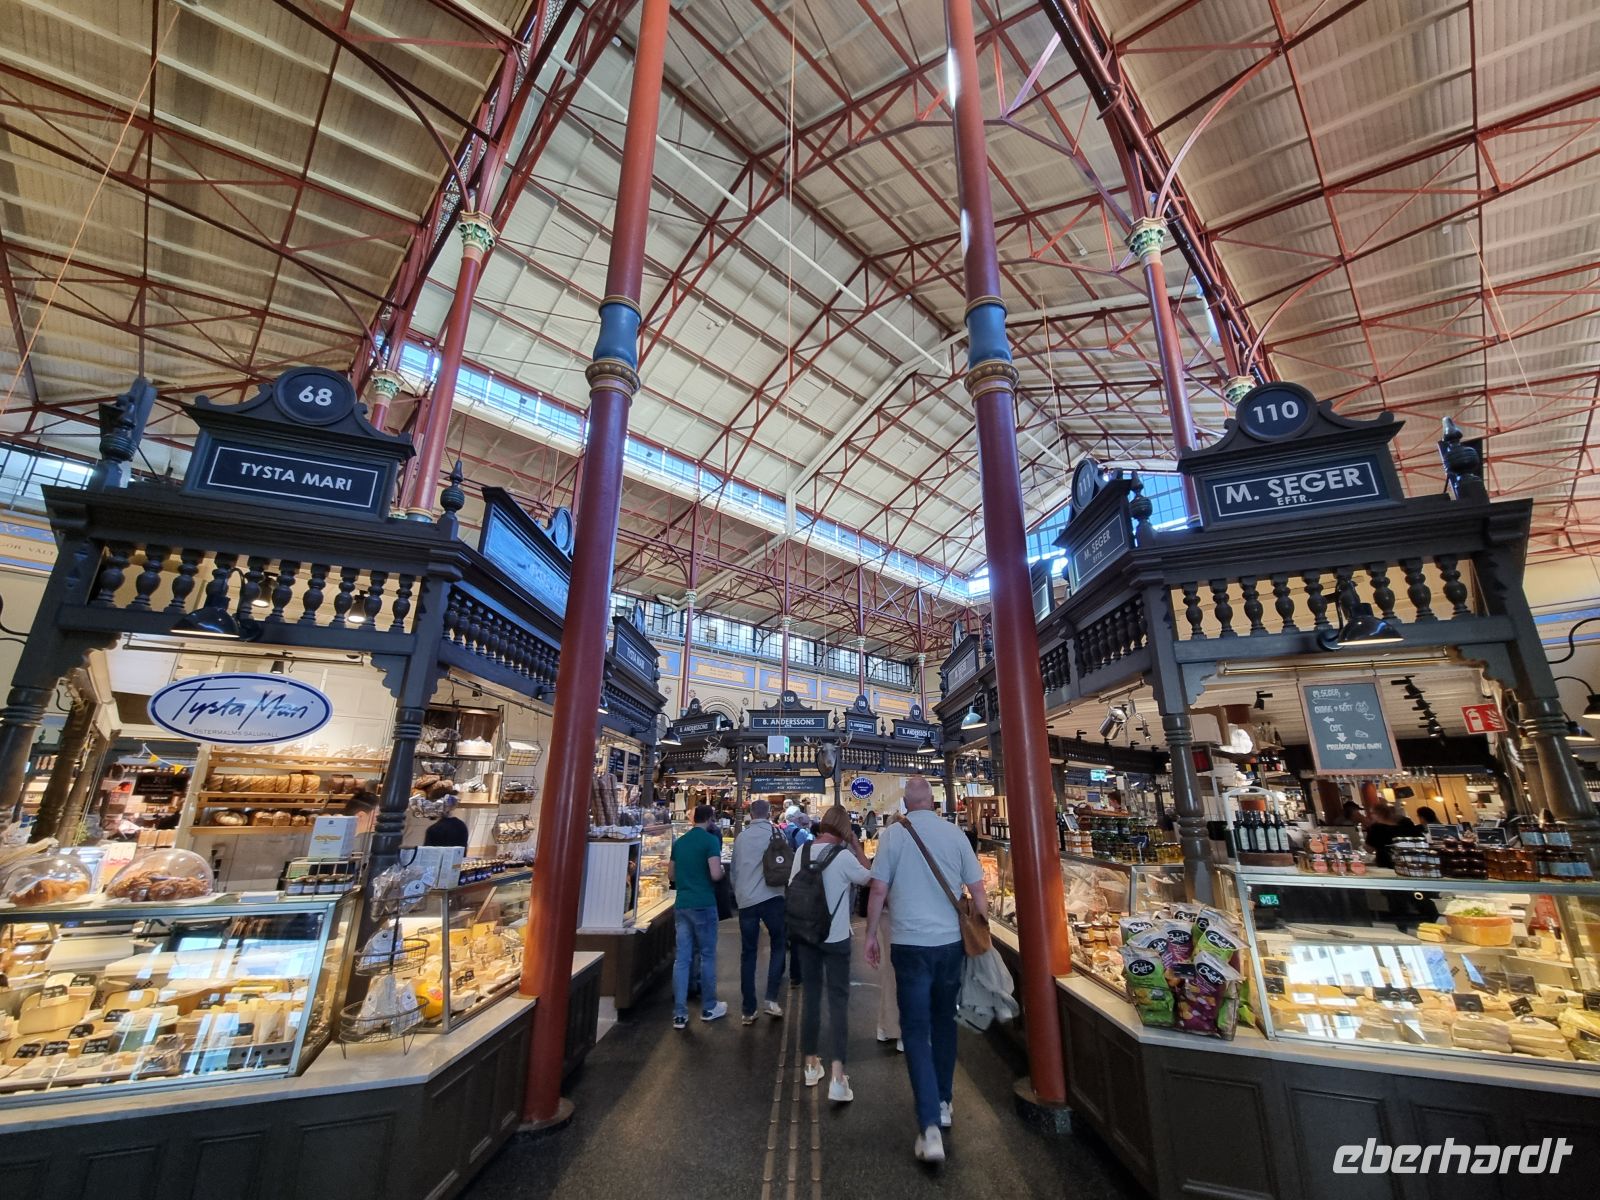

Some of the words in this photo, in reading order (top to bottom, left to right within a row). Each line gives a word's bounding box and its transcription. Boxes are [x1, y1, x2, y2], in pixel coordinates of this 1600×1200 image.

[299, 385, 333, 407] 68
[1252, 400, 1299, 424] 110
[241, 462, 296, 483] TYSTA
[301, 472, 353, 491] MARI
[1079, 473, 1091, 496] 111
[1226, 483, 1260, 504] M.
[1269, 468, 1363, 498] SEGER
[1277, 494, 1313, 506] EFTR.
[1084, 548, 1092, 561] M.
[1091, 529, 1111, 553] SEGER
[172, 683, 245, 725] Tysta
[238, 689, 314, 731] Mari
[762, 718, 769, 726] B.
[770, 718, 815, 726] ANDERSSONS
[243, 730, 279, 738] SALUHALL
